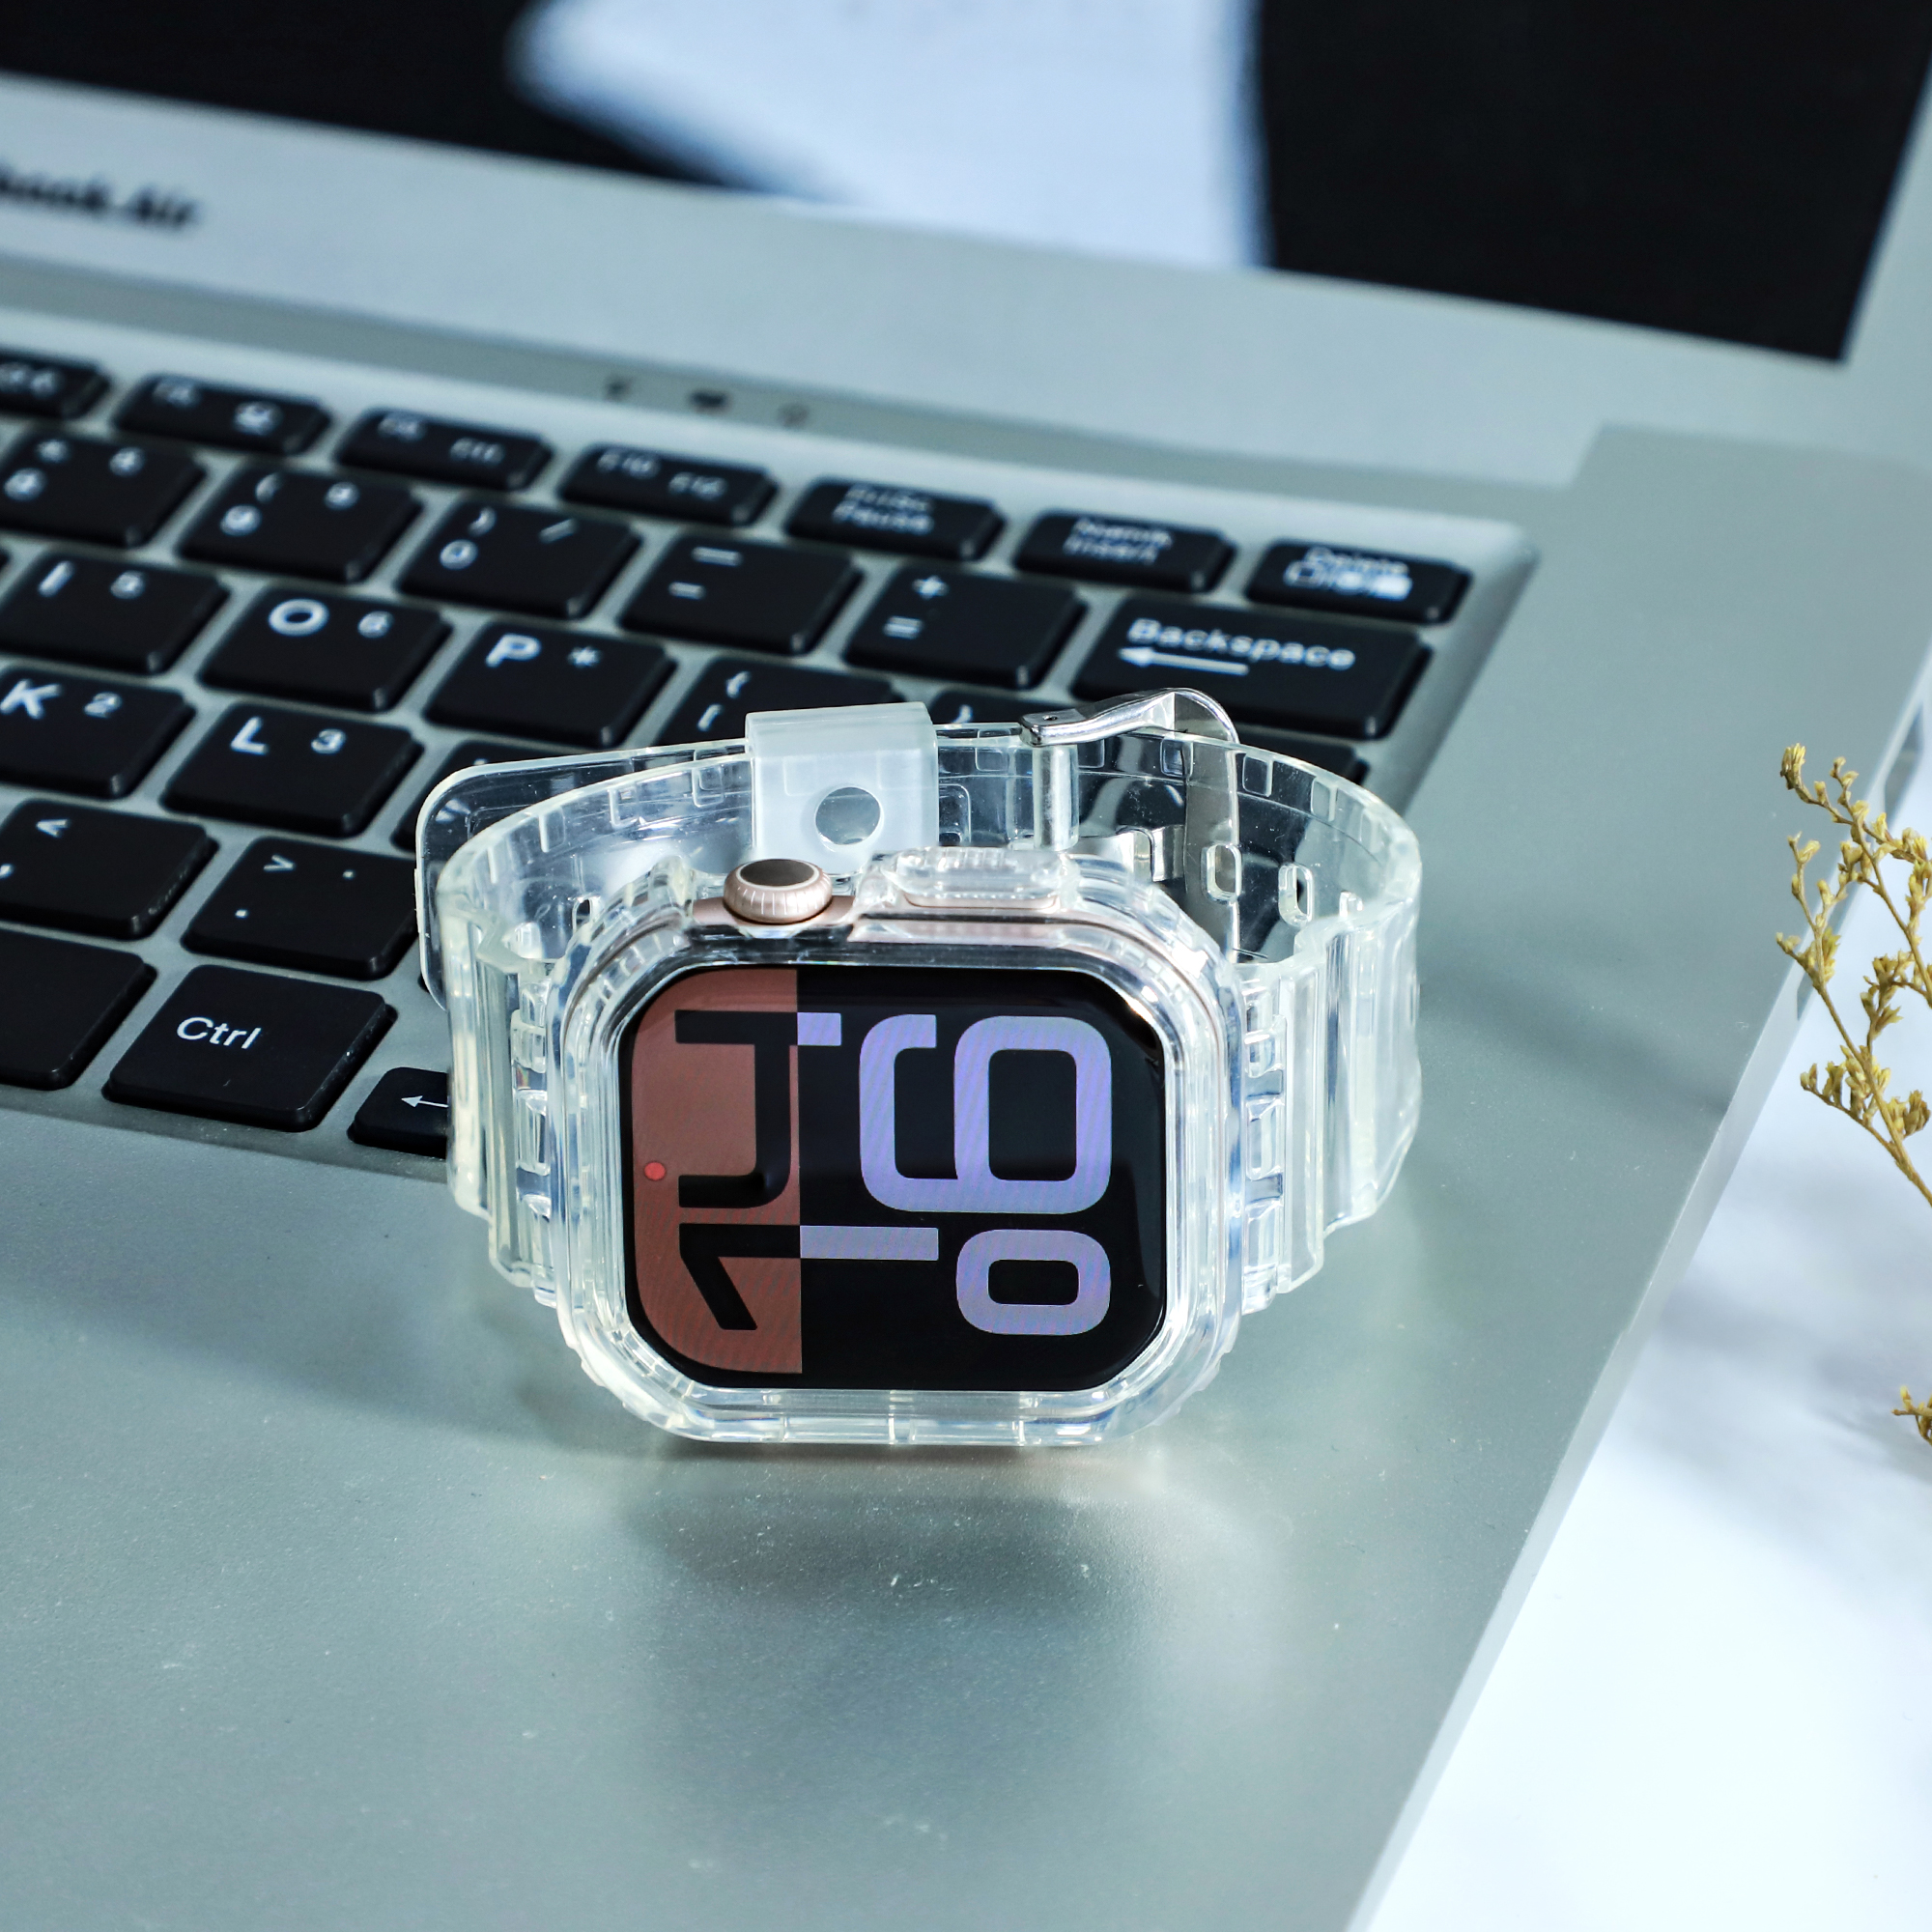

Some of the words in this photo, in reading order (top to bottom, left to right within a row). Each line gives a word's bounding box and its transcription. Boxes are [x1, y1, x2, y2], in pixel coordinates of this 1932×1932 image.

[268, 597, 329, 638] O
[485, 633, 541, 668] P
[1127, 617, 1355, 671] Backspace
[0, 678, 62, 719] K
[230, 716, 270, 755] L
[176, 1016, 262, 1051] Ctrl
[674, 1009, 939, 1330] 14
